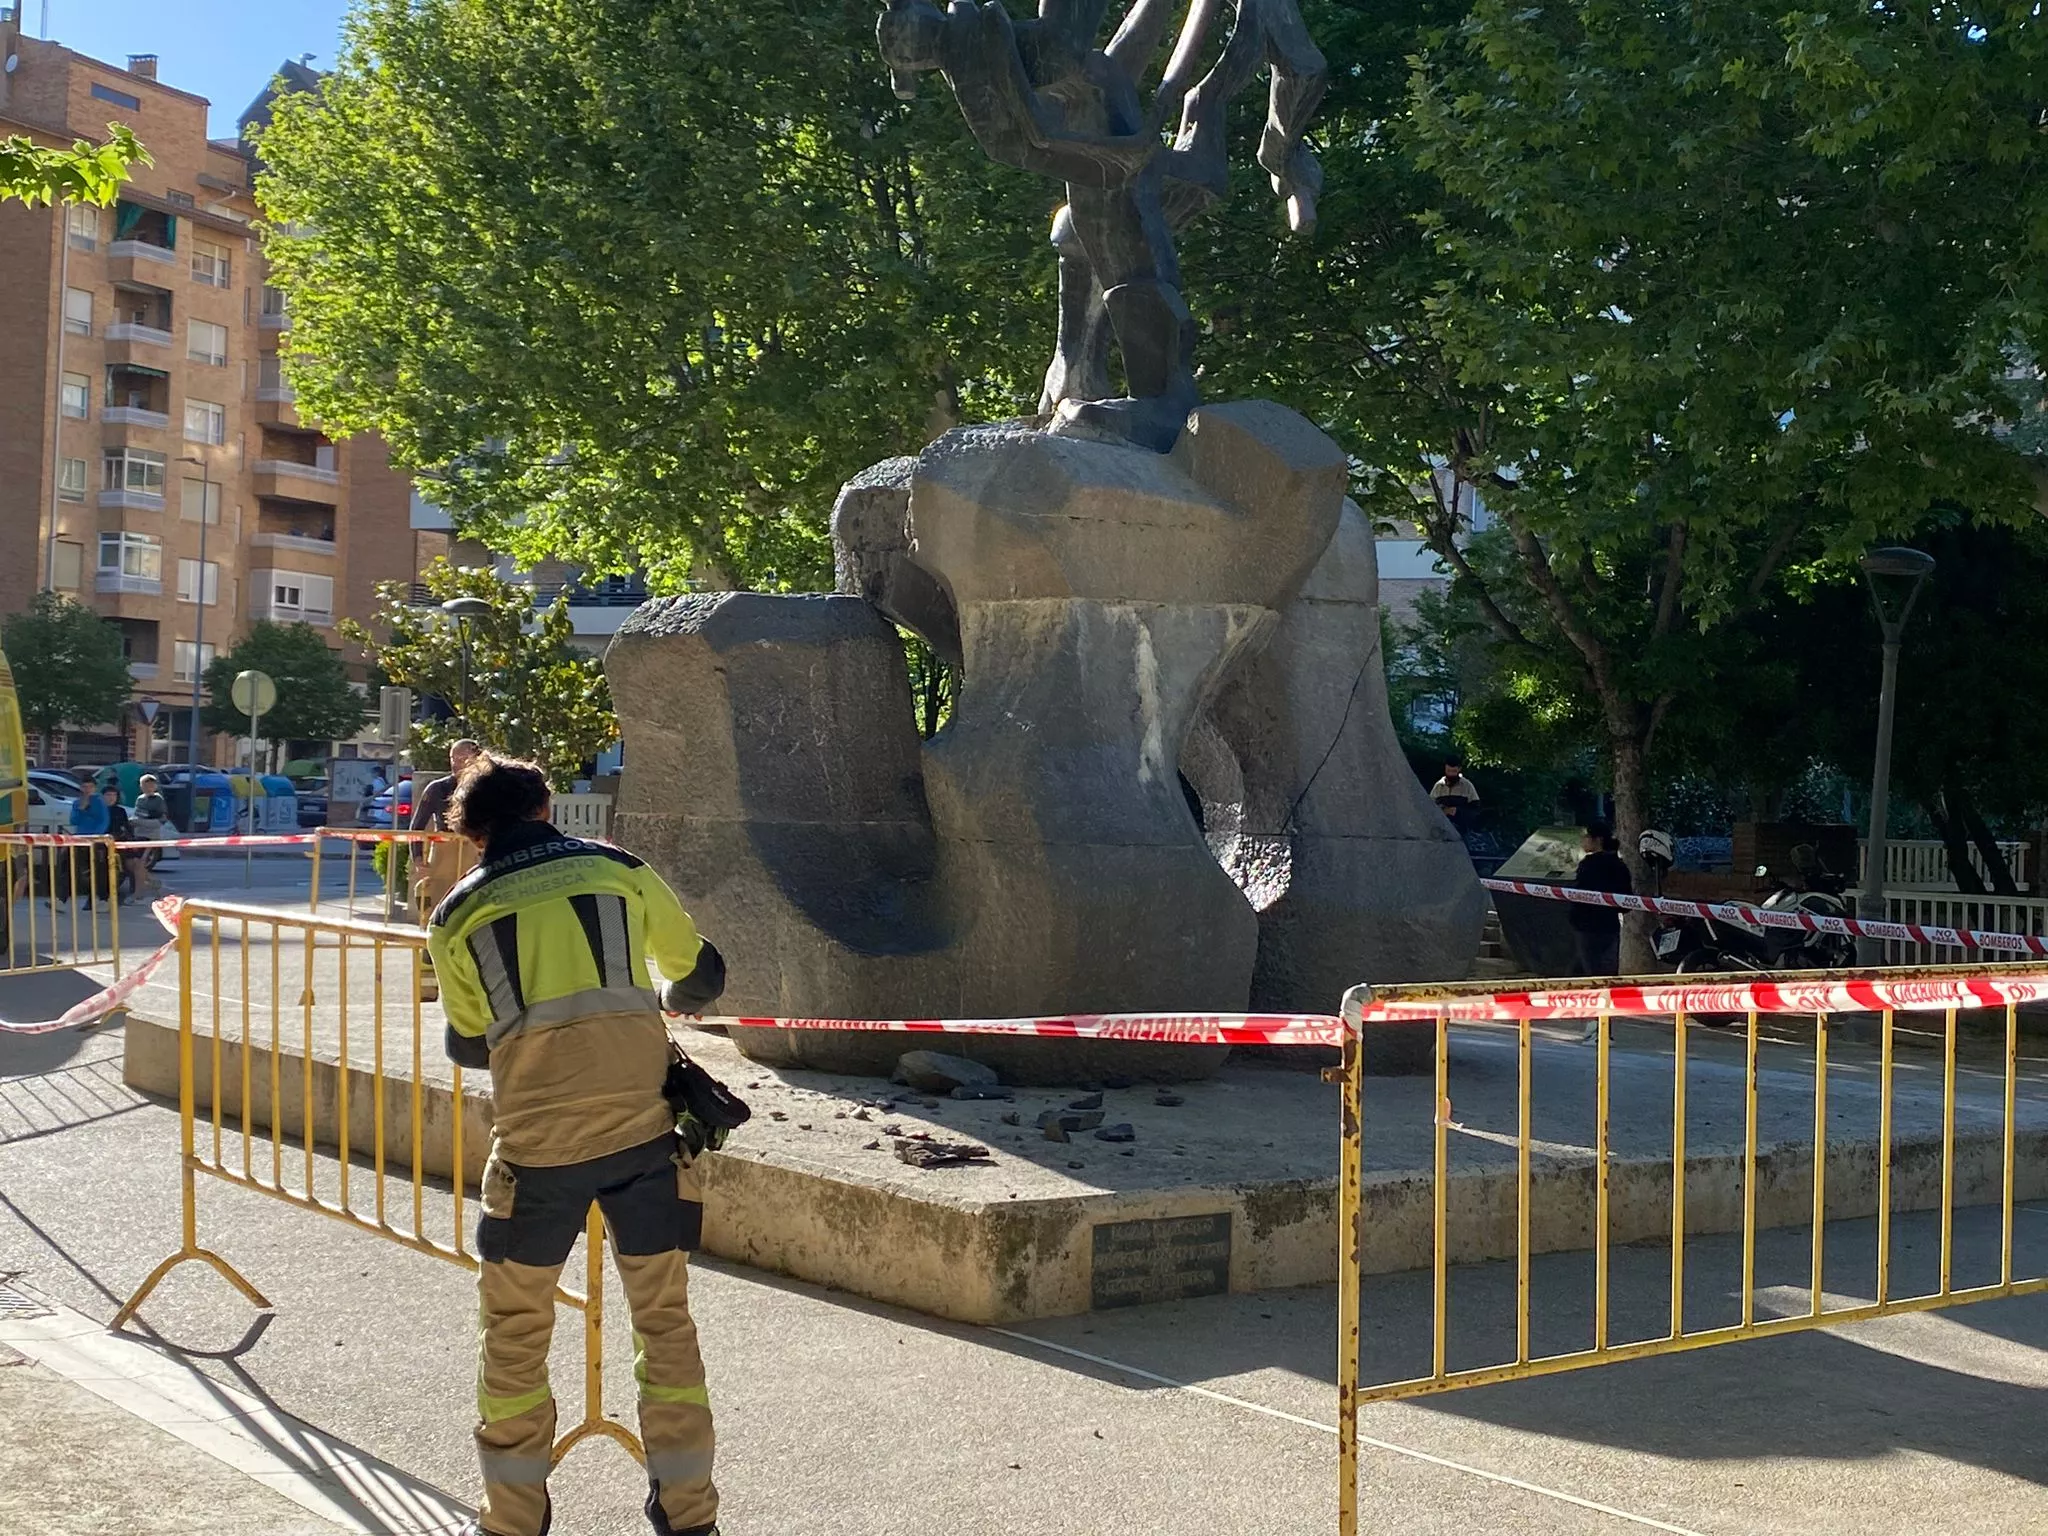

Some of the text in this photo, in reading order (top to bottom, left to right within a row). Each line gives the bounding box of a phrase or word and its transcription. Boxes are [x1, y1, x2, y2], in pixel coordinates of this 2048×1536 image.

[518, 873, 586, 896] HUESCA
[1660, 900, 1696, 916] BOMBEROS
[1720, 907, 1736, 915] NO
[1759, 912, 1797, 928] BOMBEROS
[1824, 918, 1840, 926] NO
[1865, 923, 1906, 939] BOMBEROS
[1935, 929, 1952, 937] NO
[1979, 933, 2023, 950] BOMBEROS
